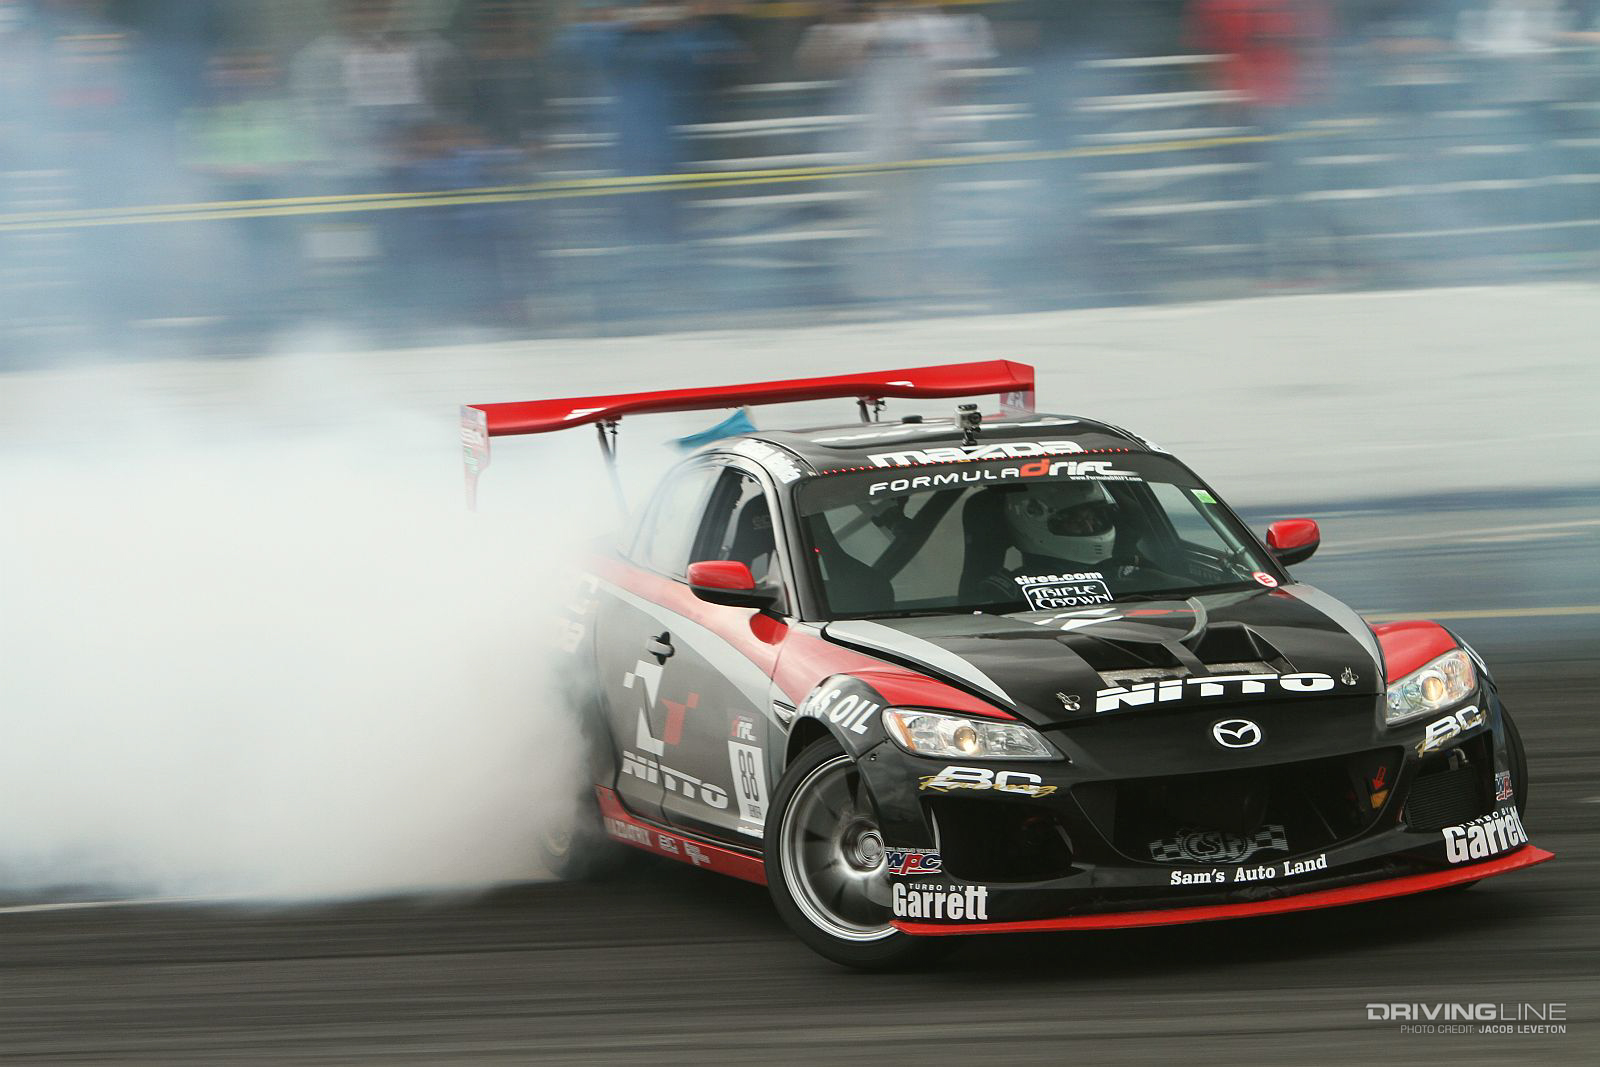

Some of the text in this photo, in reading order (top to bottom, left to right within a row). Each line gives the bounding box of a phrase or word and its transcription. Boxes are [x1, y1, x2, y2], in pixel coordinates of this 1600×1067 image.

[1014, 571, 1104, 585] tires.com
[1028, 584, 1097, 599] TRIPLE
[1034, 593, 1111, 610] CROWN
[1095, 672, 1335, 713] NITTO
[829, 694, 880, 735] OIL
[1424, 705, 1481, 751] BC
[622, 750, 728, 809] NITTO
[738, 748, 760, 802] 88
[927, 765, 1043, 795] BC
[1441, 805, 1529, 864] Garrett
[908, 883, 964, 892] TURBO BY
[1170, 853, 1328, 886] Sam's Auto Land
[892, 882, 988, 920] Garrett
